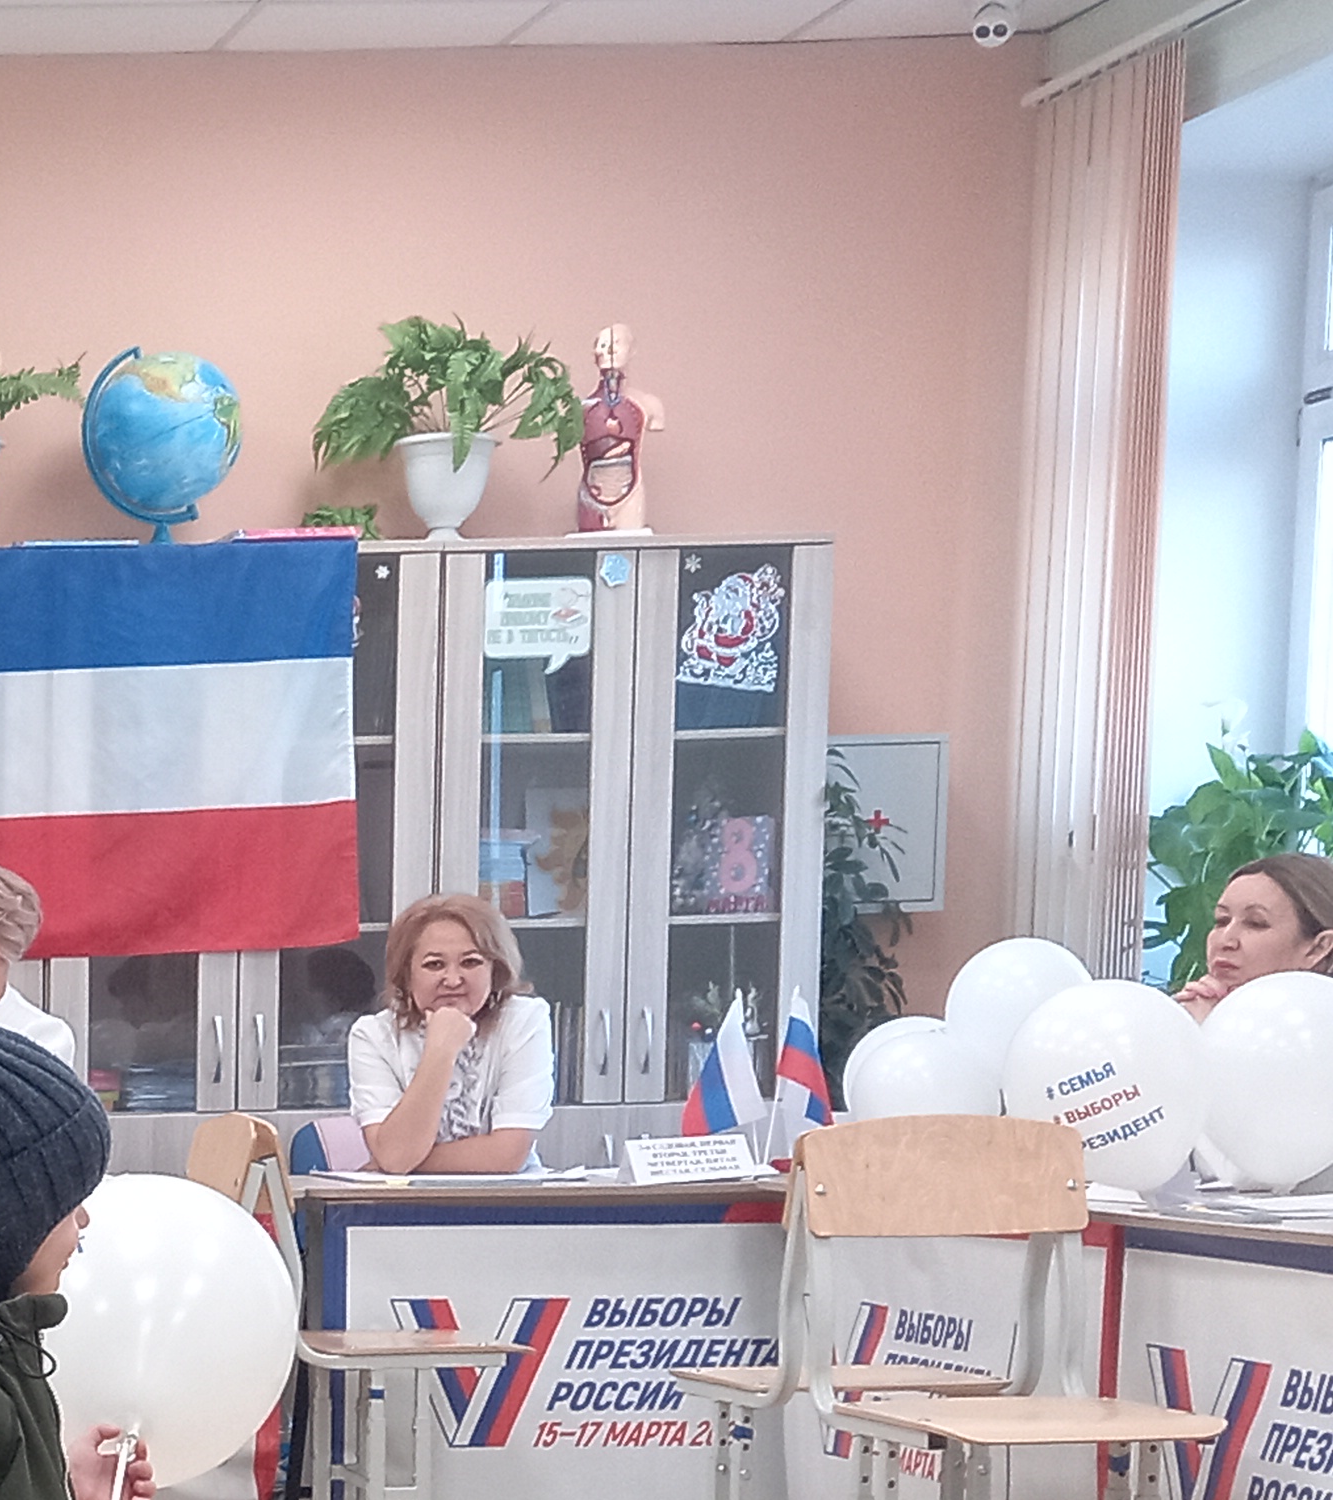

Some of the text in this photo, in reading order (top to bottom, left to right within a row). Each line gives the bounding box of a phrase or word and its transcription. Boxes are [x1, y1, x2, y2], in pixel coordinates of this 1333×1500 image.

[1058, 1062, 1116, 1095] СЕМЬЯ
[1064, 1084, 1141, 1124] ВЫБОРЫ
[1081, 1106, 1164, 1150] РЕЗИДЕНТ
[583, 1297, 742, 1328] ВЫБОРЫ
[894, 1308, 973, 1352] ВЫБОРЫ
[564, 1338, 779, 1370] ПРЕЗИДЕНТА
[546, 1381, 686, 1412] РОССИИ
[603, 1421, 688, 1448] МАРТА
